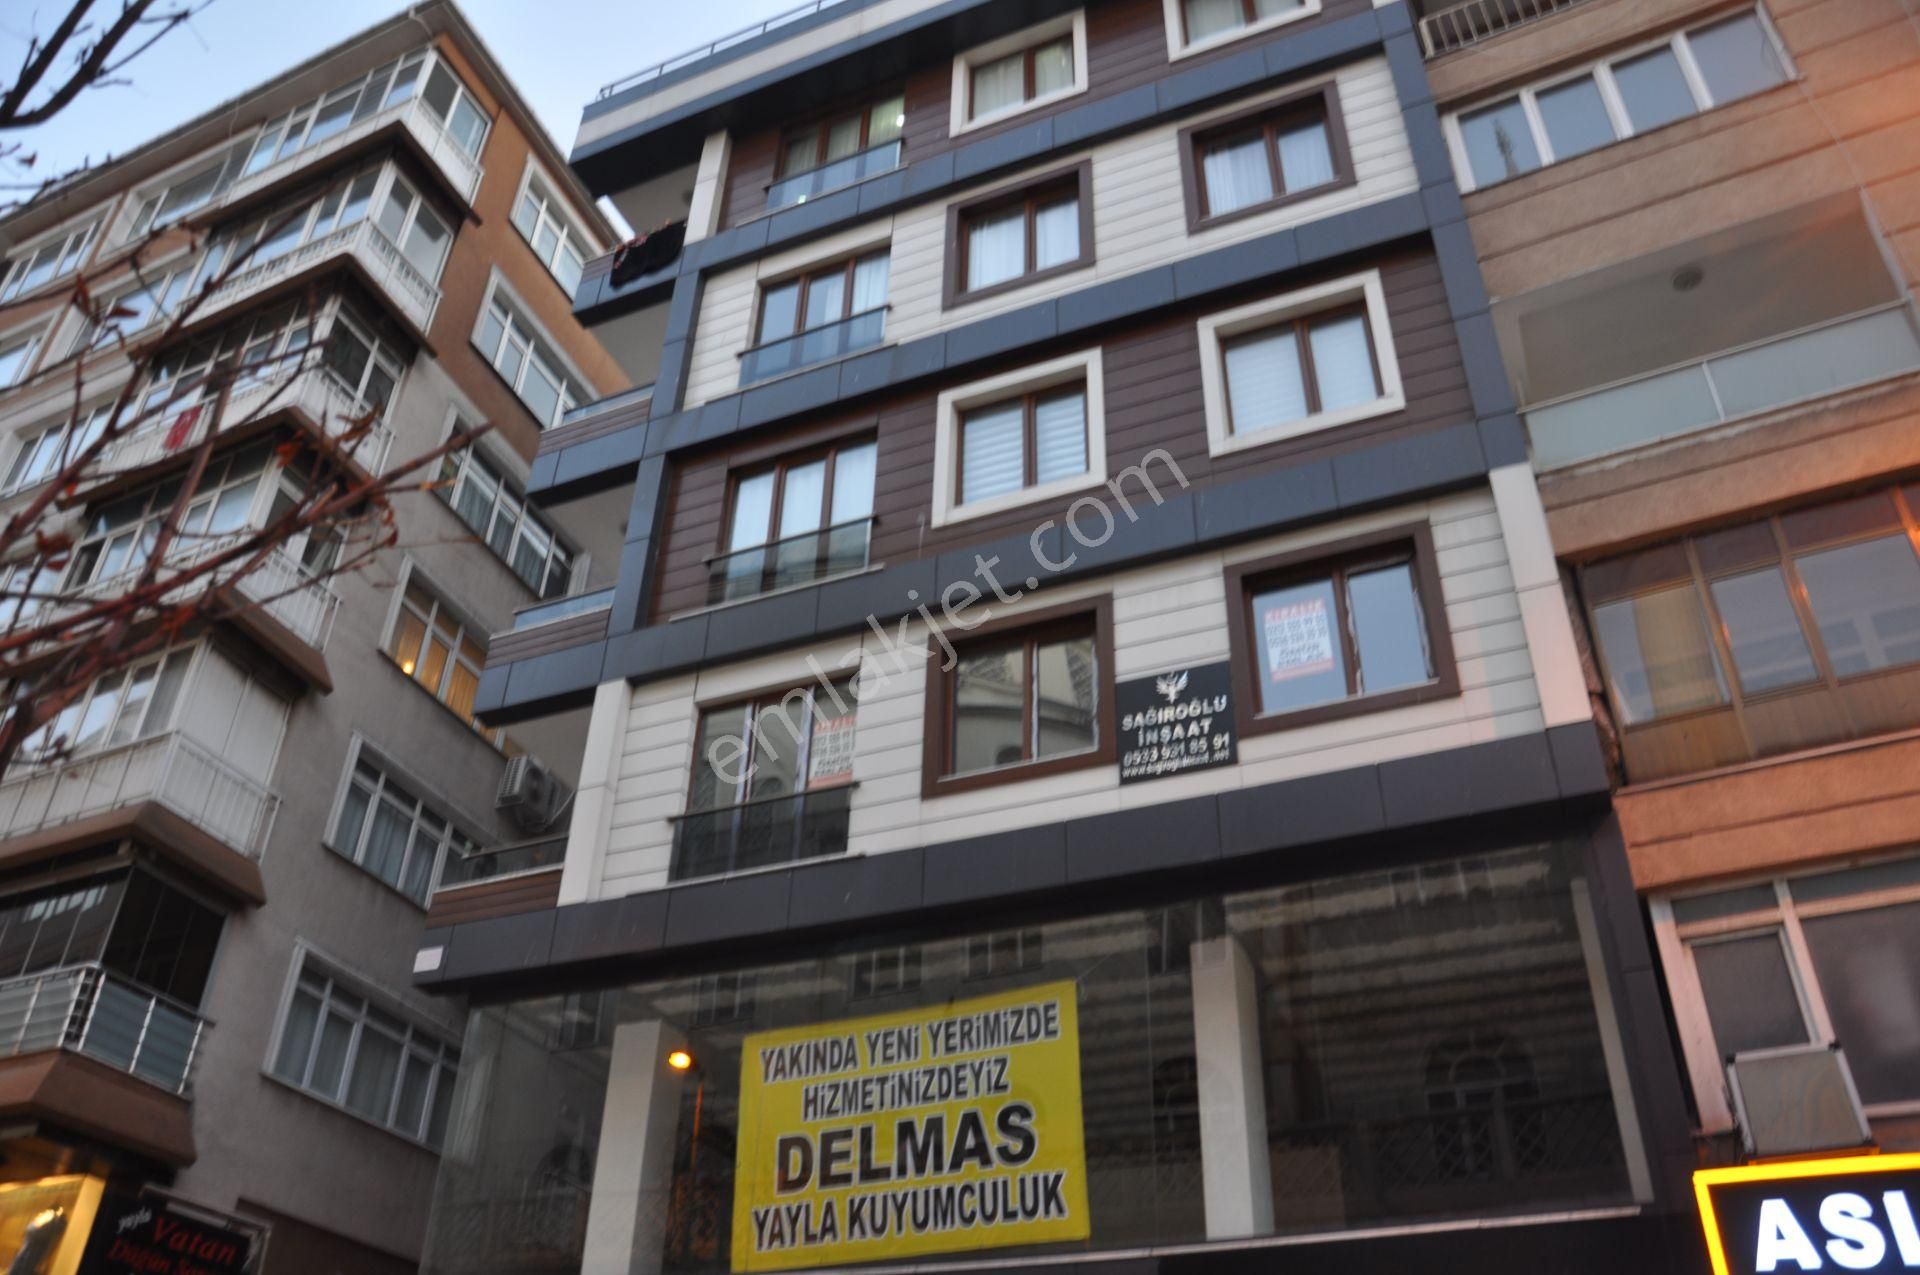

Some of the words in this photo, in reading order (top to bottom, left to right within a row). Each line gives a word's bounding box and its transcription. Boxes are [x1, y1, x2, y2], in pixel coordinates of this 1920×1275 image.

[761, 1036, 857, 1083] YAKINDA
[775, 1101, 1036, 1195] DELMAS
[152, 1215, 237, 1265] Vatan
[752, 1199, 838, 1251] YAYLA
[847, 1170, 1066, 1240] KUYUMCULUK
